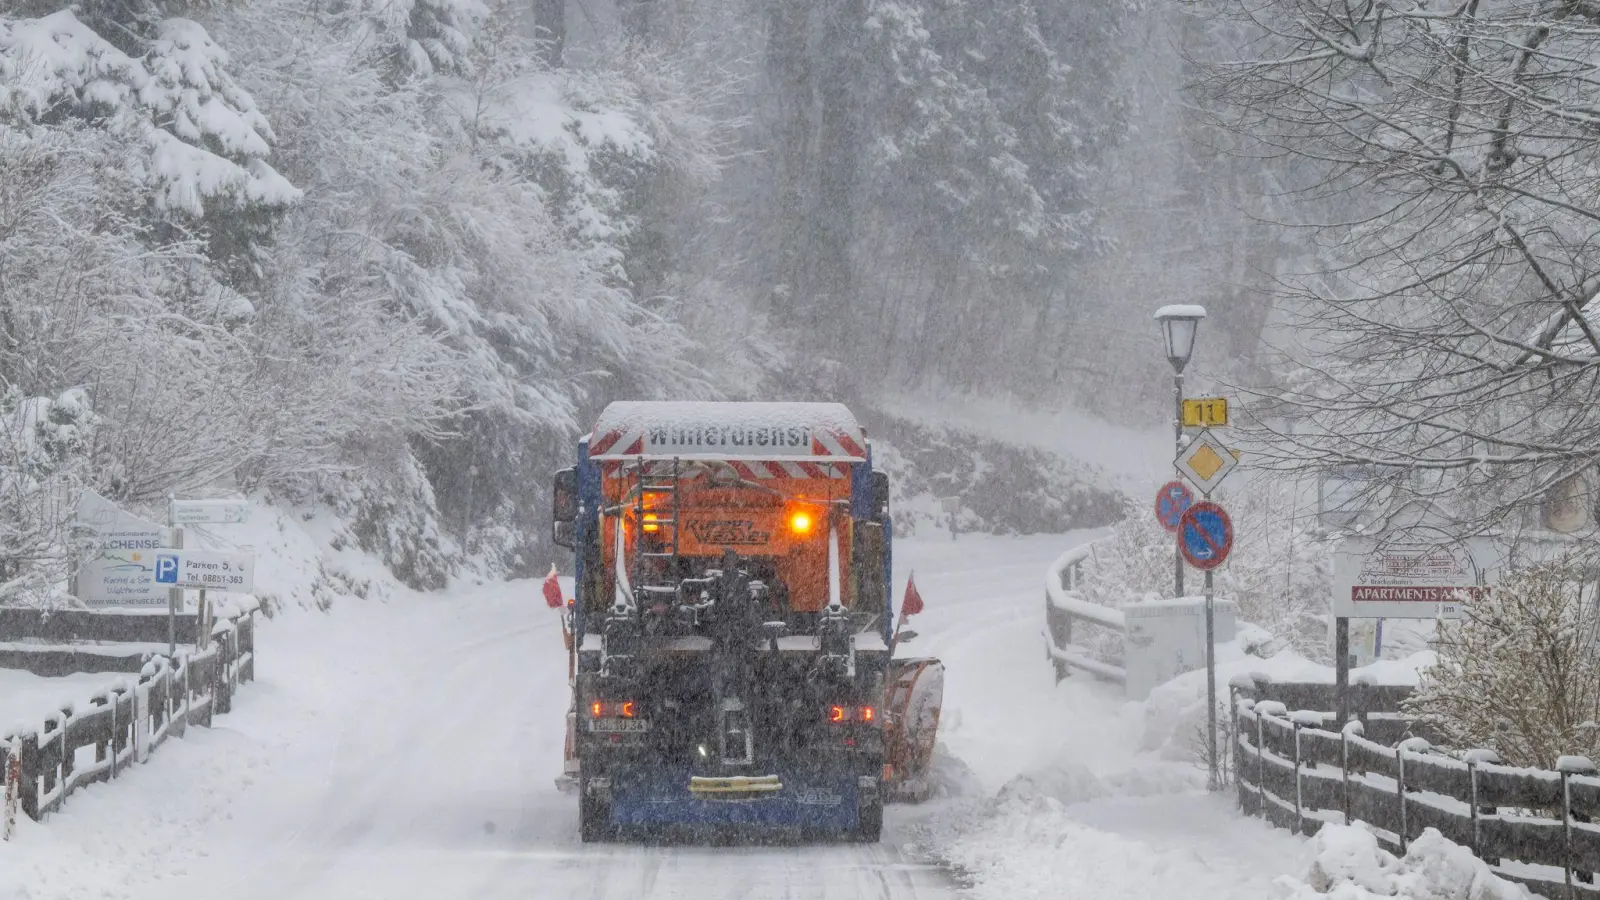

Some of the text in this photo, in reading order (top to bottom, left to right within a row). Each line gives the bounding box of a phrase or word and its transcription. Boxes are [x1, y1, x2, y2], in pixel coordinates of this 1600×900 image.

[1195, 403, 1214, 422] 11
[84, 539, 167, 550] LCHENSE
[159, 557, 177, 580] P
[186, 560, 218, 570] Parken
[202, 574, 243, 584] 08851-363
[1355, 588, 1437, 599] APARTMENTS
